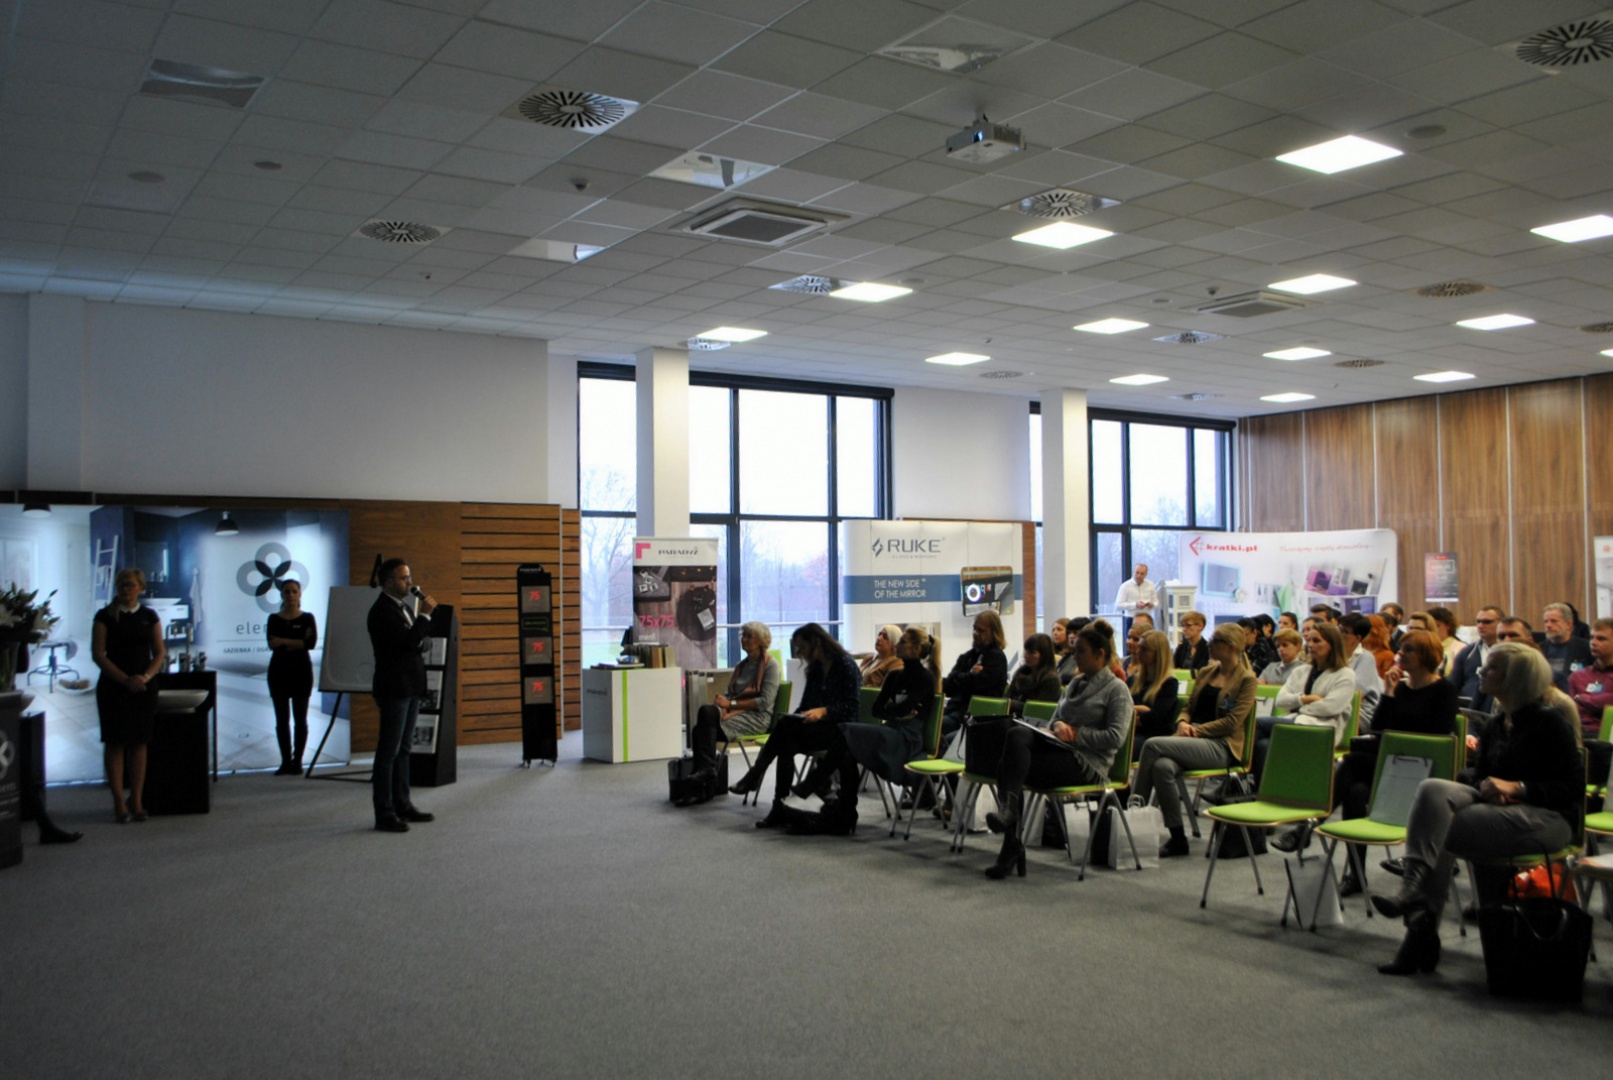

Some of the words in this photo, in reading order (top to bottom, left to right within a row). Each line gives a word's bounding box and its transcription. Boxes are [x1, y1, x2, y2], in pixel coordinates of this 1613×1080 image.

[887, 538, 942, 553] RUKE
[1206, 544, 1258, 553] kratki.pl
[874, 580, 887, 588] THE
[888, 580, 904, 588] NEW
[905, 579, 920, 588] SIDE
[874, 590, 885, 598] OF
[886, 590, 899, 598] THE
[900, 589, 927, 598] MIRROR
[639, 614, 675, 628] 75x75
[532, 641, 544, 652] 75
[532, 681, 544, 693] 75
